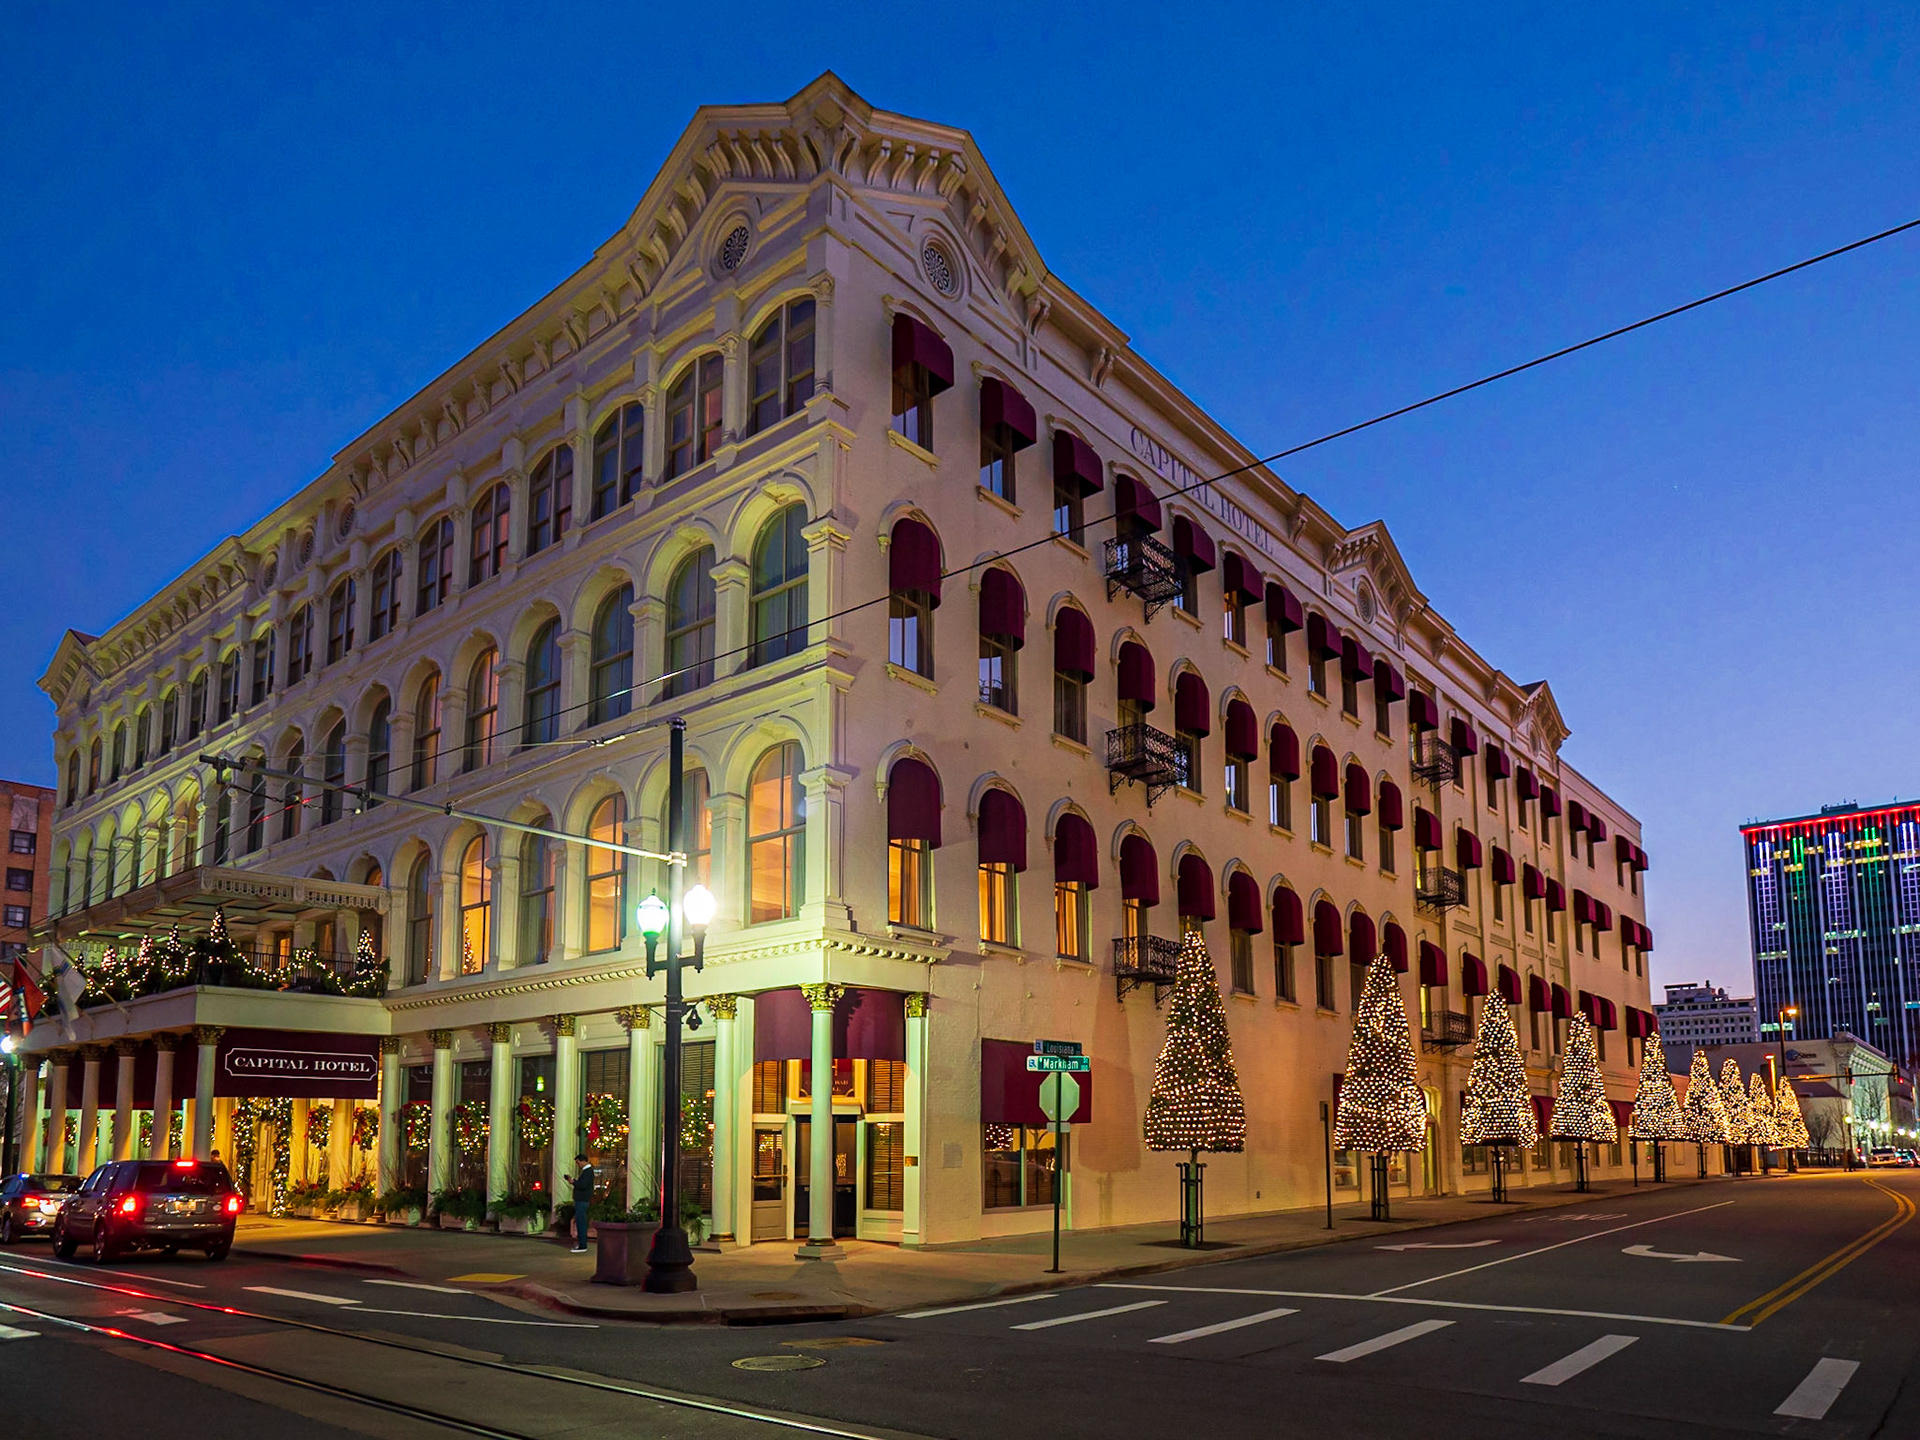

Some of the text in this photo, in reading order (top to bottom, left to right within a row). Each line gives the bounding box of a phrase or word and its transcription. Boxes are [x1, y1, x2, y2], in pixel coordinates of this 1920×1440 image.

[1130, 426, 1274, 556] CAPITAL HOTEL
[1046, 1042, 1074, 1055] Louisiana
[234, 1056, 370, 1073] CAPITAL HOTEL
[1043, 1058, 1079, 1070] Markham
